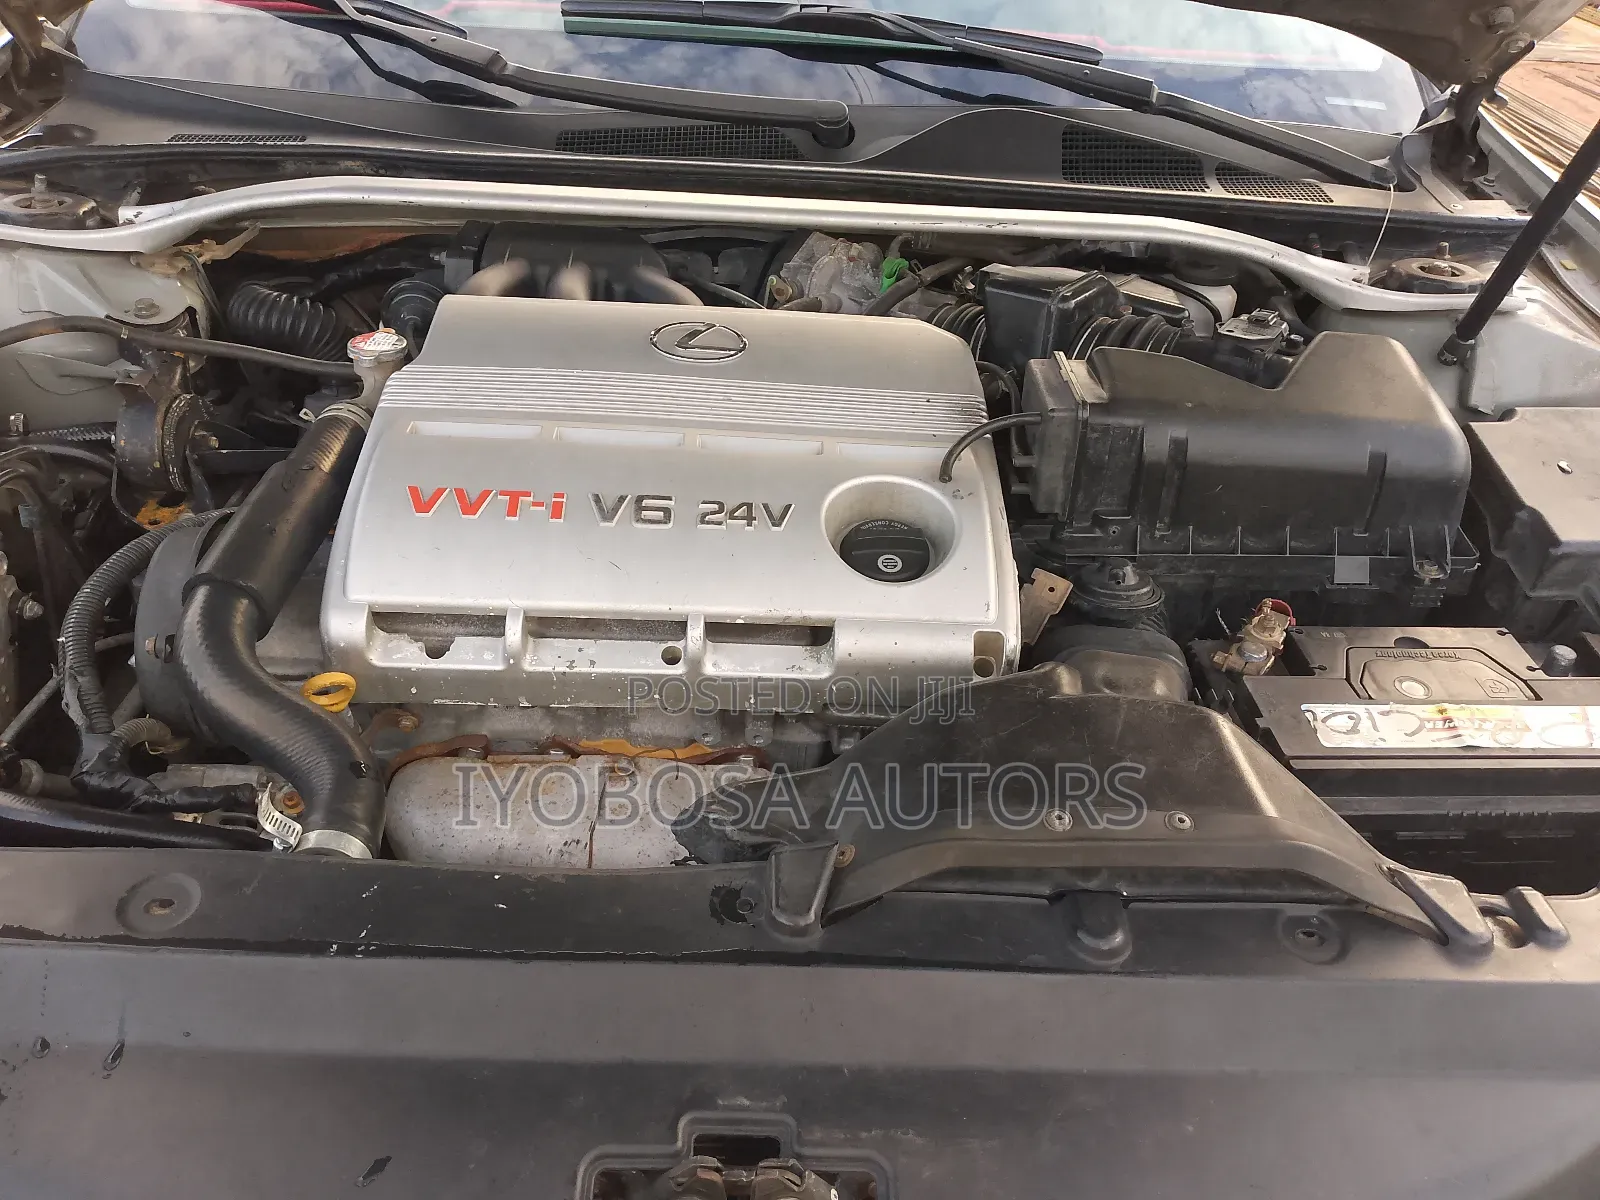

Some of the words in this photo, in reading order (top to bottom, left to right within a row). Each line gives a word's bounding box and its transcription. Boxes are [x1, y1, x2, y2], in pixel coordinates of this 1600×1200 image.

[407, 485, 568, 523] VVT-i
[588, 493, 676, 530] V6
[697, 500, 796, 532] 24V
